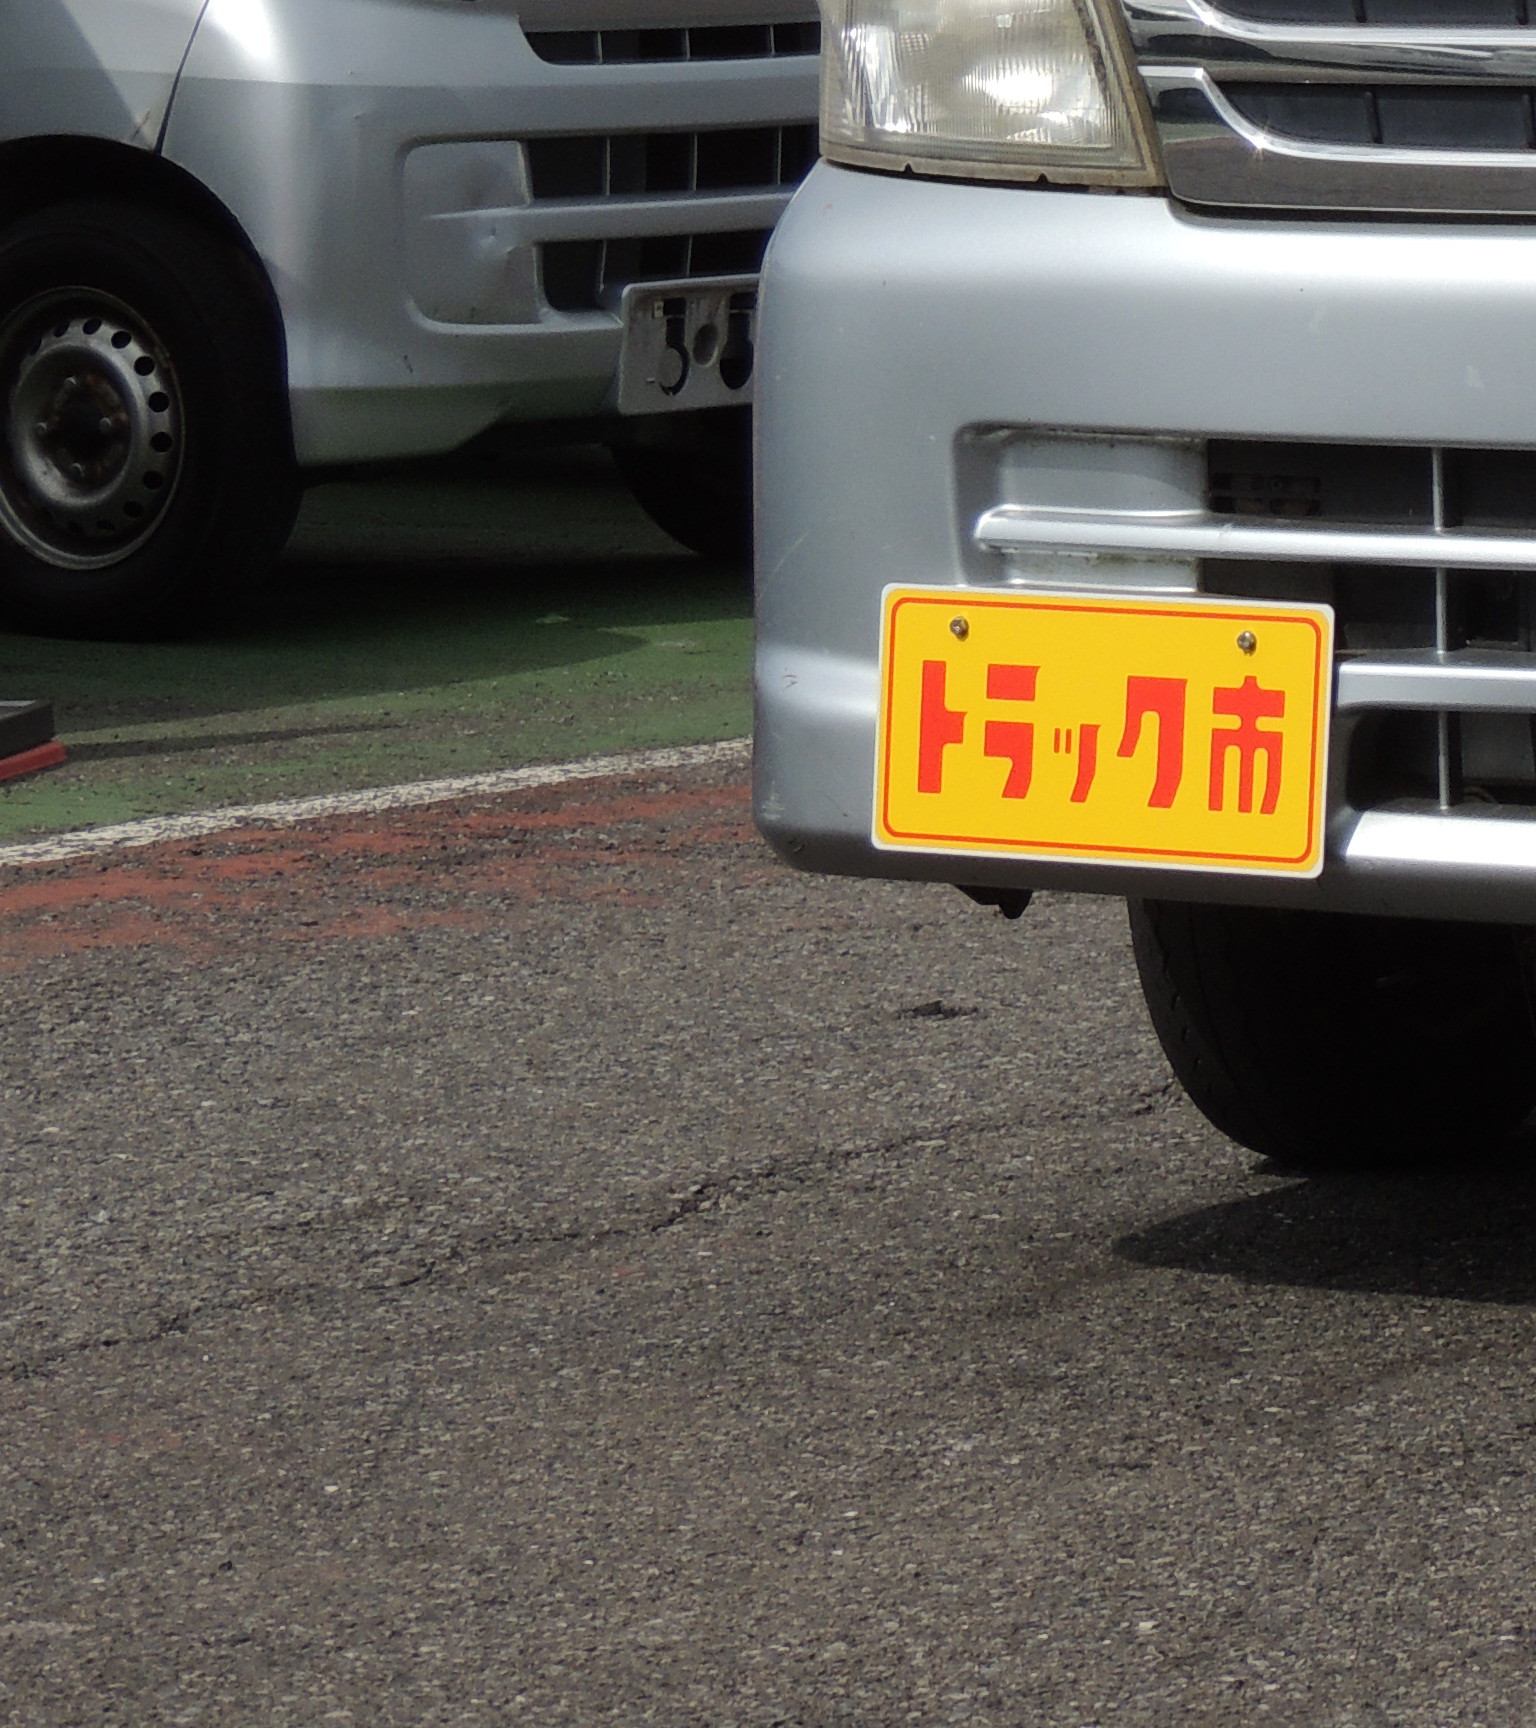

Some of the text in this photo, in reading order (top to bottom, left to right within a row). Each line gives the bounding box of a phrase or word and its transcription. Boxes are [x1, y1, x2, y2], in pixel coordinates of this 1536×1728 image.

[917, 660, 1286, 815] トラック市
